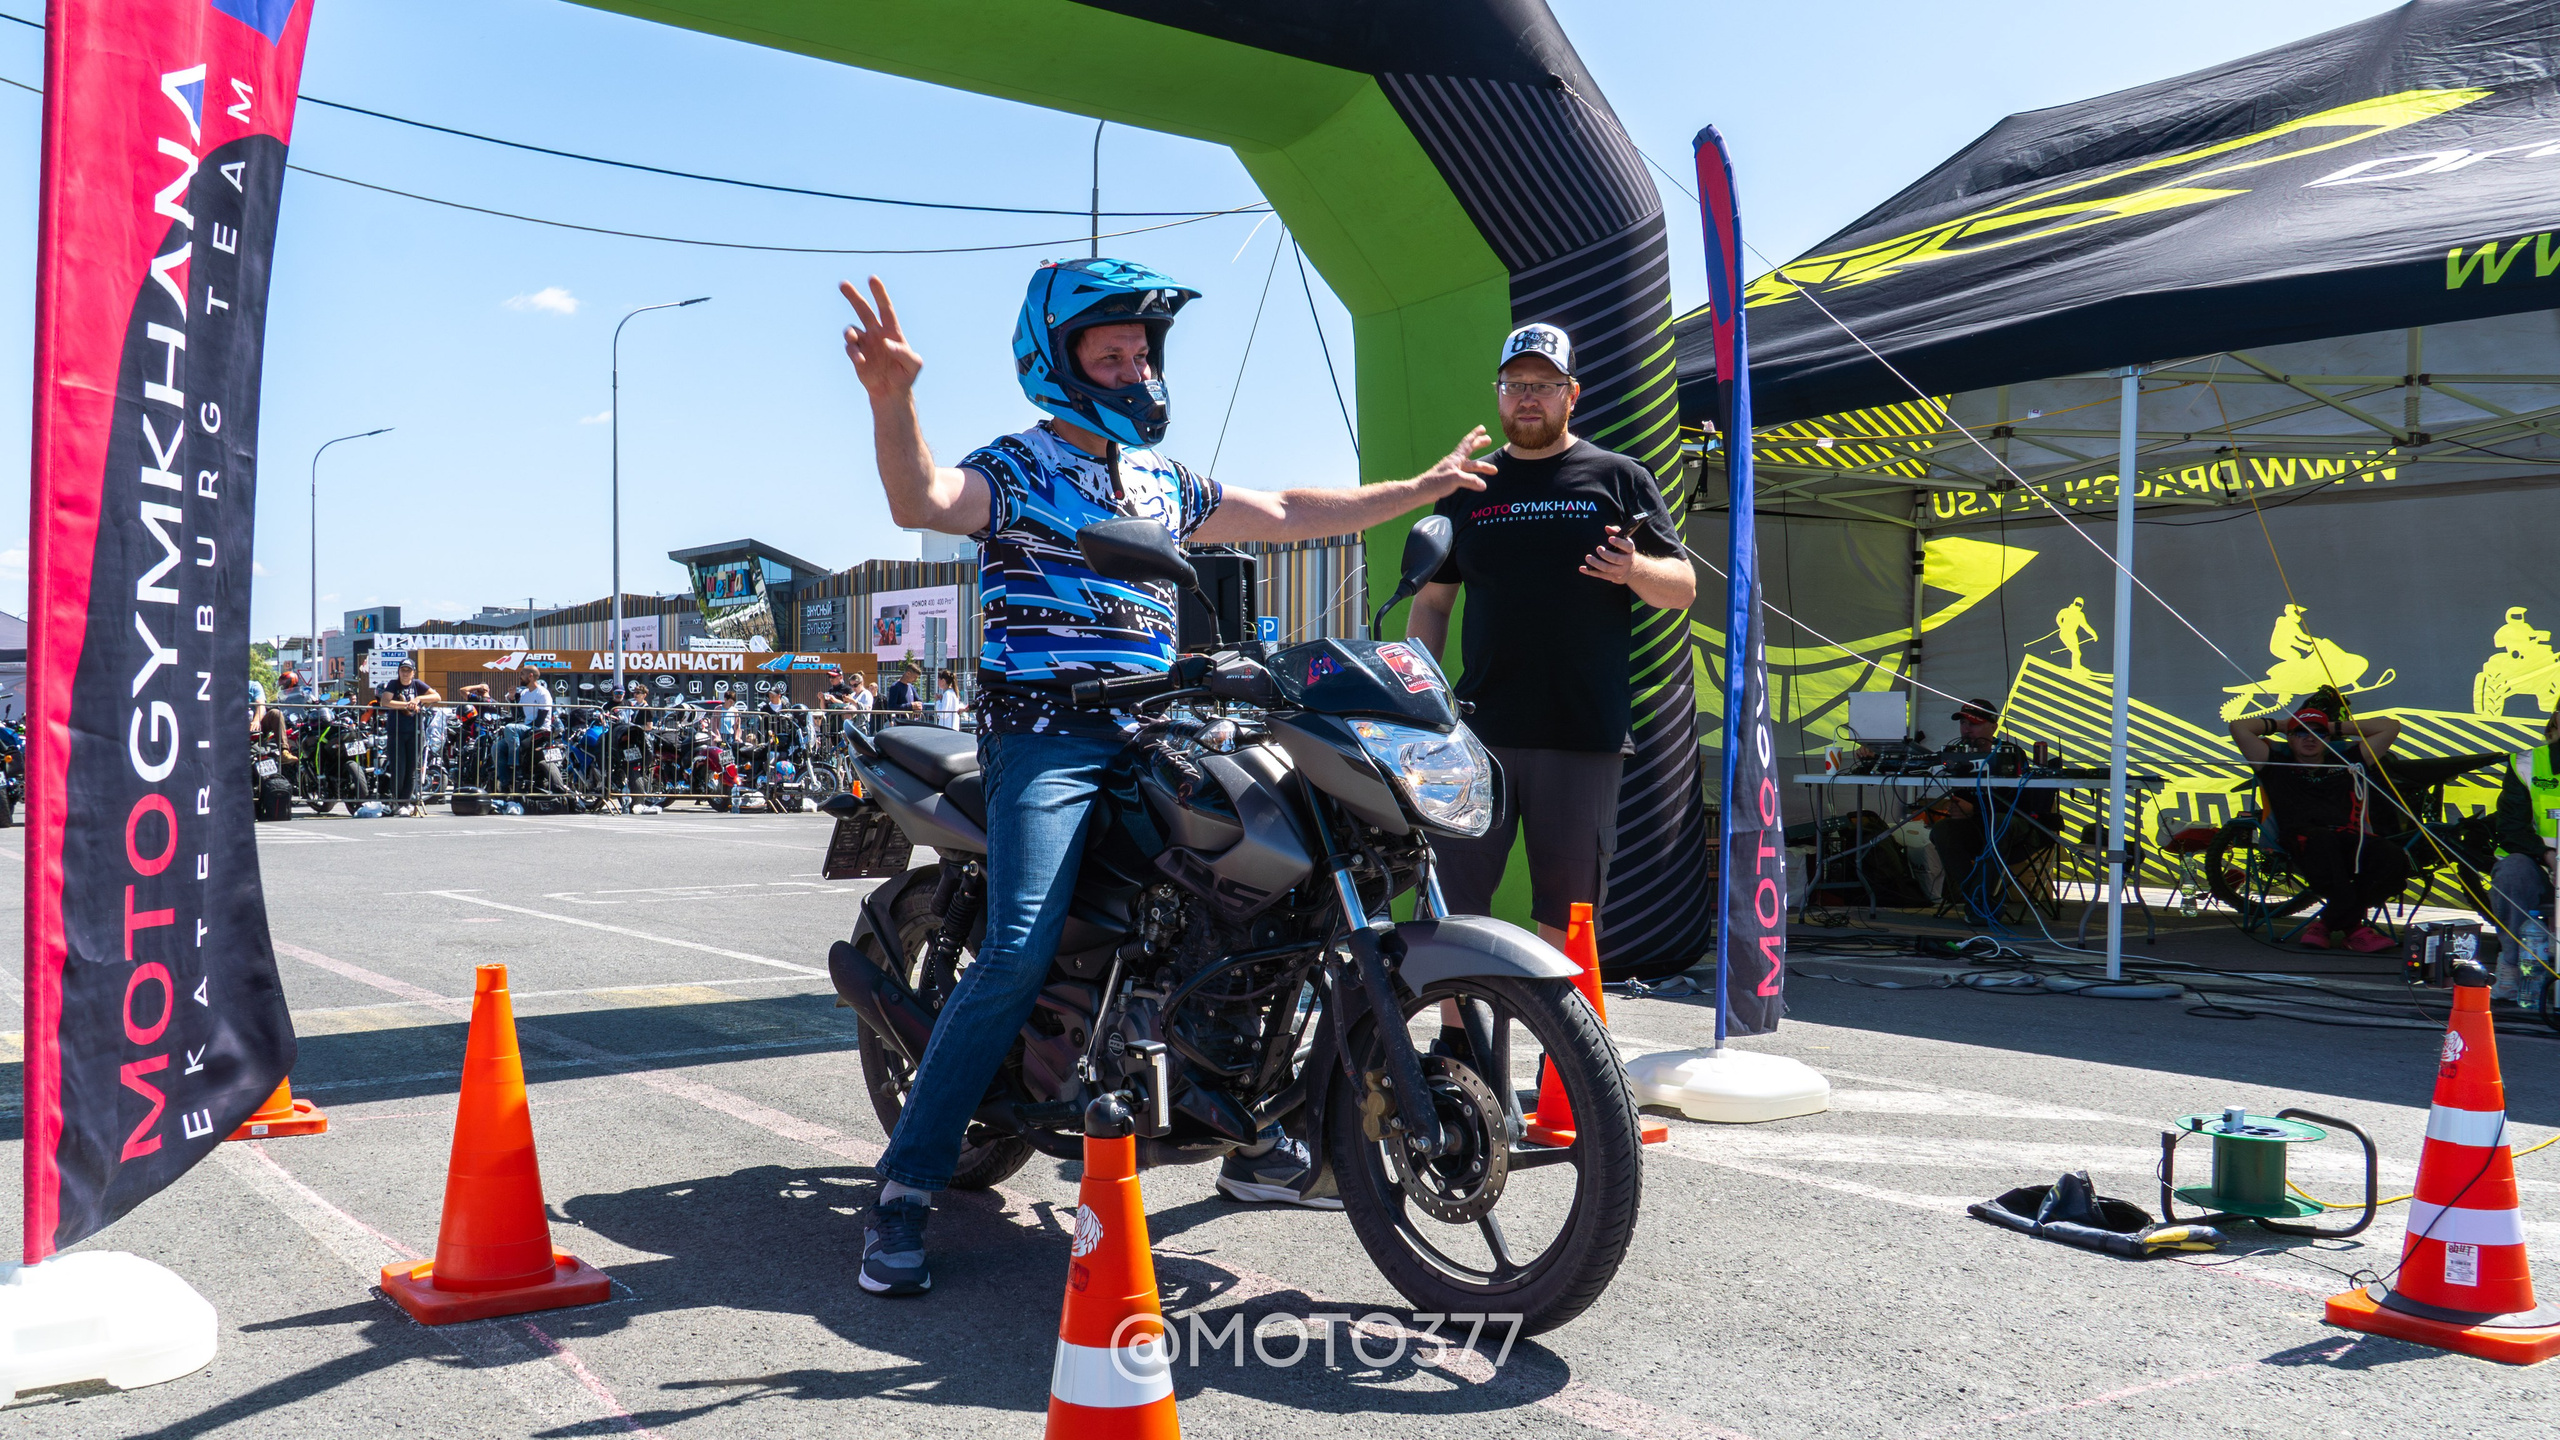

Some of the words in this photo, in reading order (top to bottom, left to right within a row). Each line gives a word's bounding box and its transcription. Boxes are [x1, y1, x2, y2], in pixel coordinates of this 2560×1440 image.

[1470, 500, 1597, 519] MOTOGYMKHANA
[1477, 514, 1554, 526] EKATERINBURG
[183, 401, 221, 1139] EKATERINBURG
[206, 77, 254, 315] TEAM
[1263, 619, 1275, 639] P
[793, 655, 820, 663] АВТО
